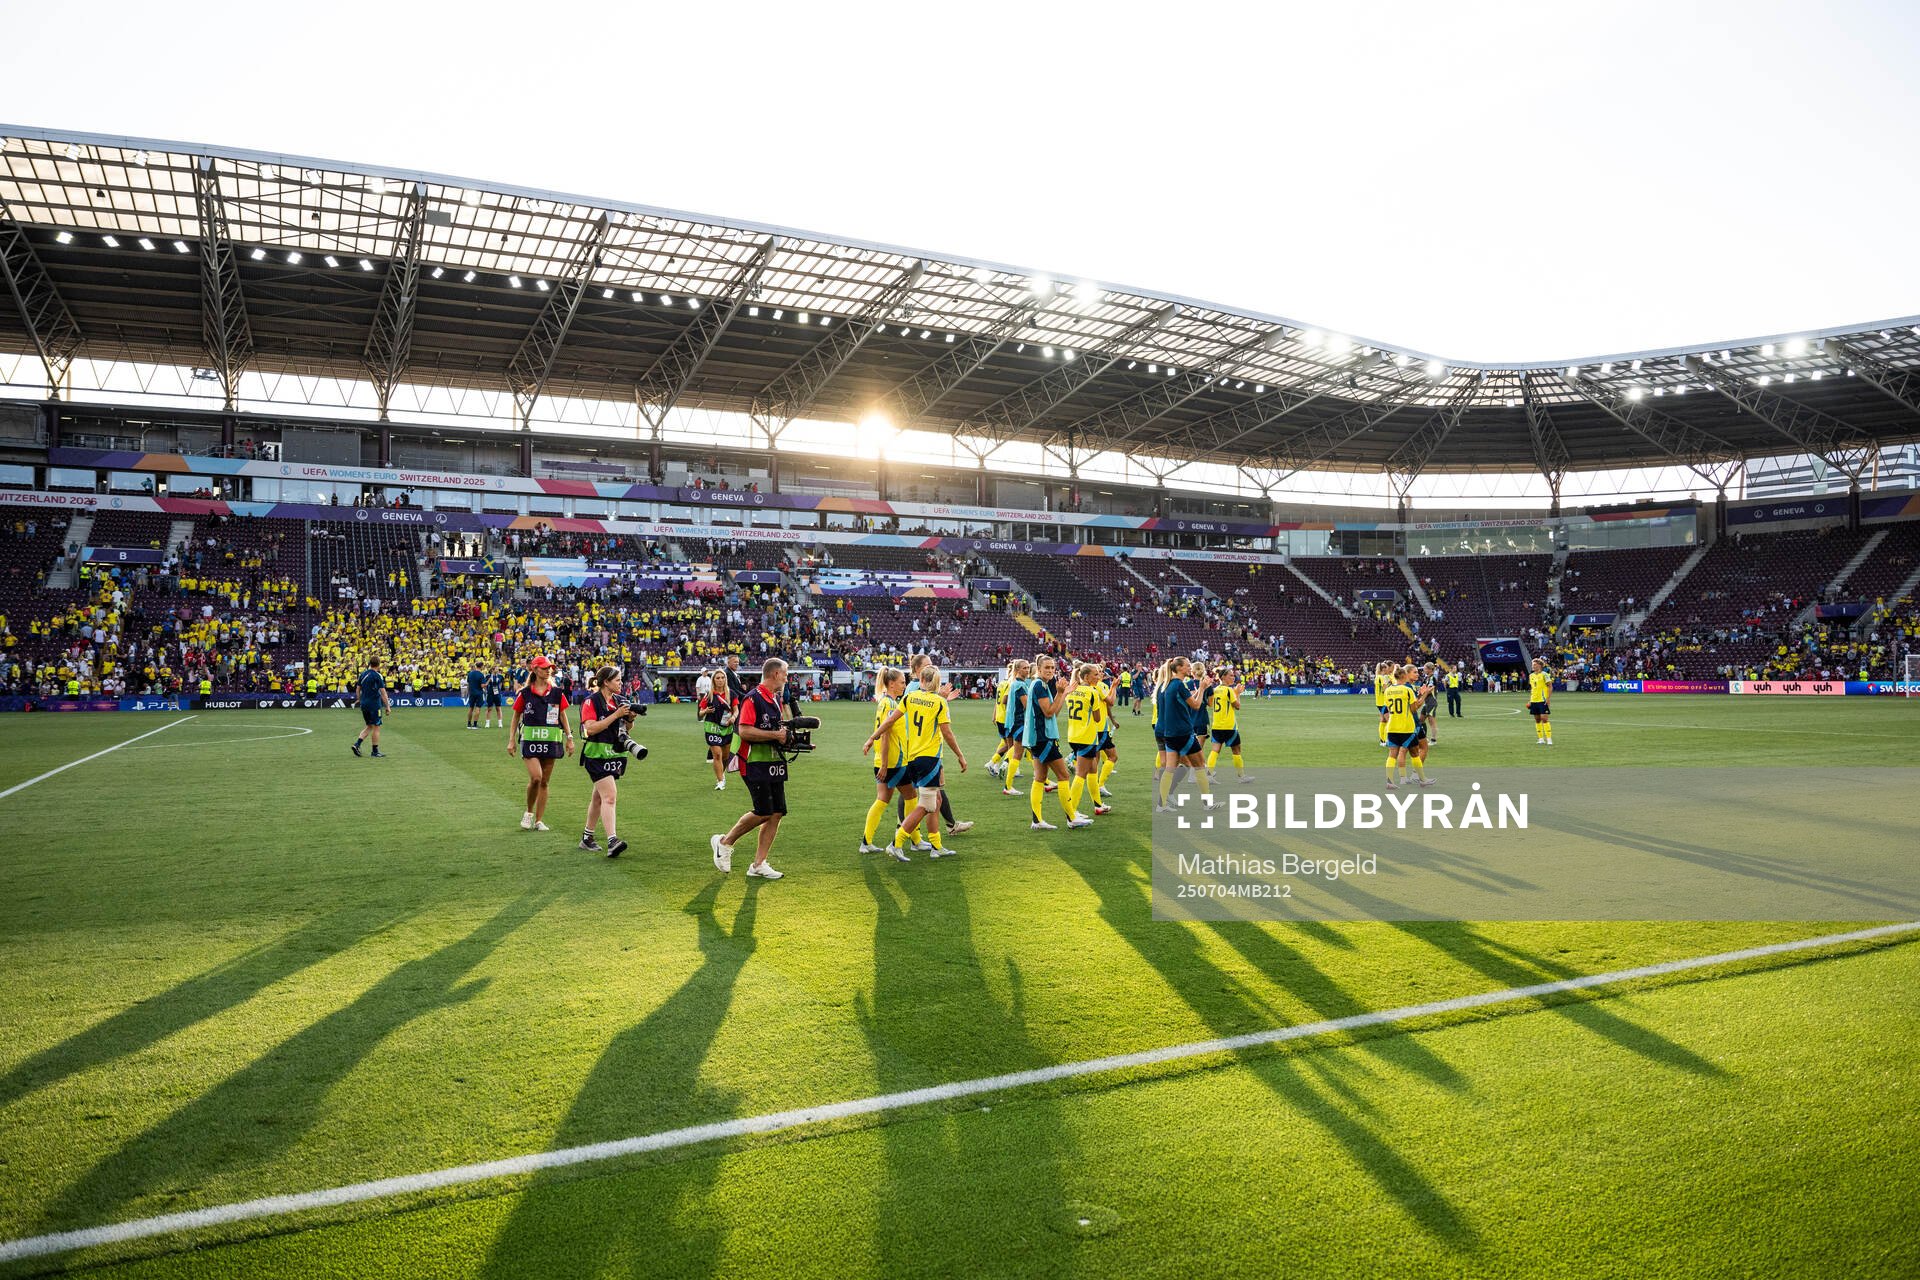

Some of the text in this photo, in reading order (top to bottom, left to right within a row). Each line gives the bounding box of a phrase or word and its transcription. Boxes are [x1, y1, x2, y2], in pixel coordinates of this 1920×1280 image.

[302, 467, 485, 485] UEFA WOMEN'S EURO SWITZERLAND 2025
[712, 493, 744, 502] GENEVA
[382, 512, 423, 521] GENEVA
[1772, 507, 1805, 516] GENEVA
[675, 527, 709, 535] WOMEN'S
[731, 530, 781, 538] SWITZERLAND
[119, 552, 127, 560] B
[1754, 682, 1832, 693] yuh yuh yuh
[1068, 700, 1083, 720] 22
[1388, 698, 1403, 714] 20
[914, 711, 923, 736] 4
[532, 728, 549, 738] HB
[529, 744, 549, 752] 035
[769, 765, 785, 776] 016
